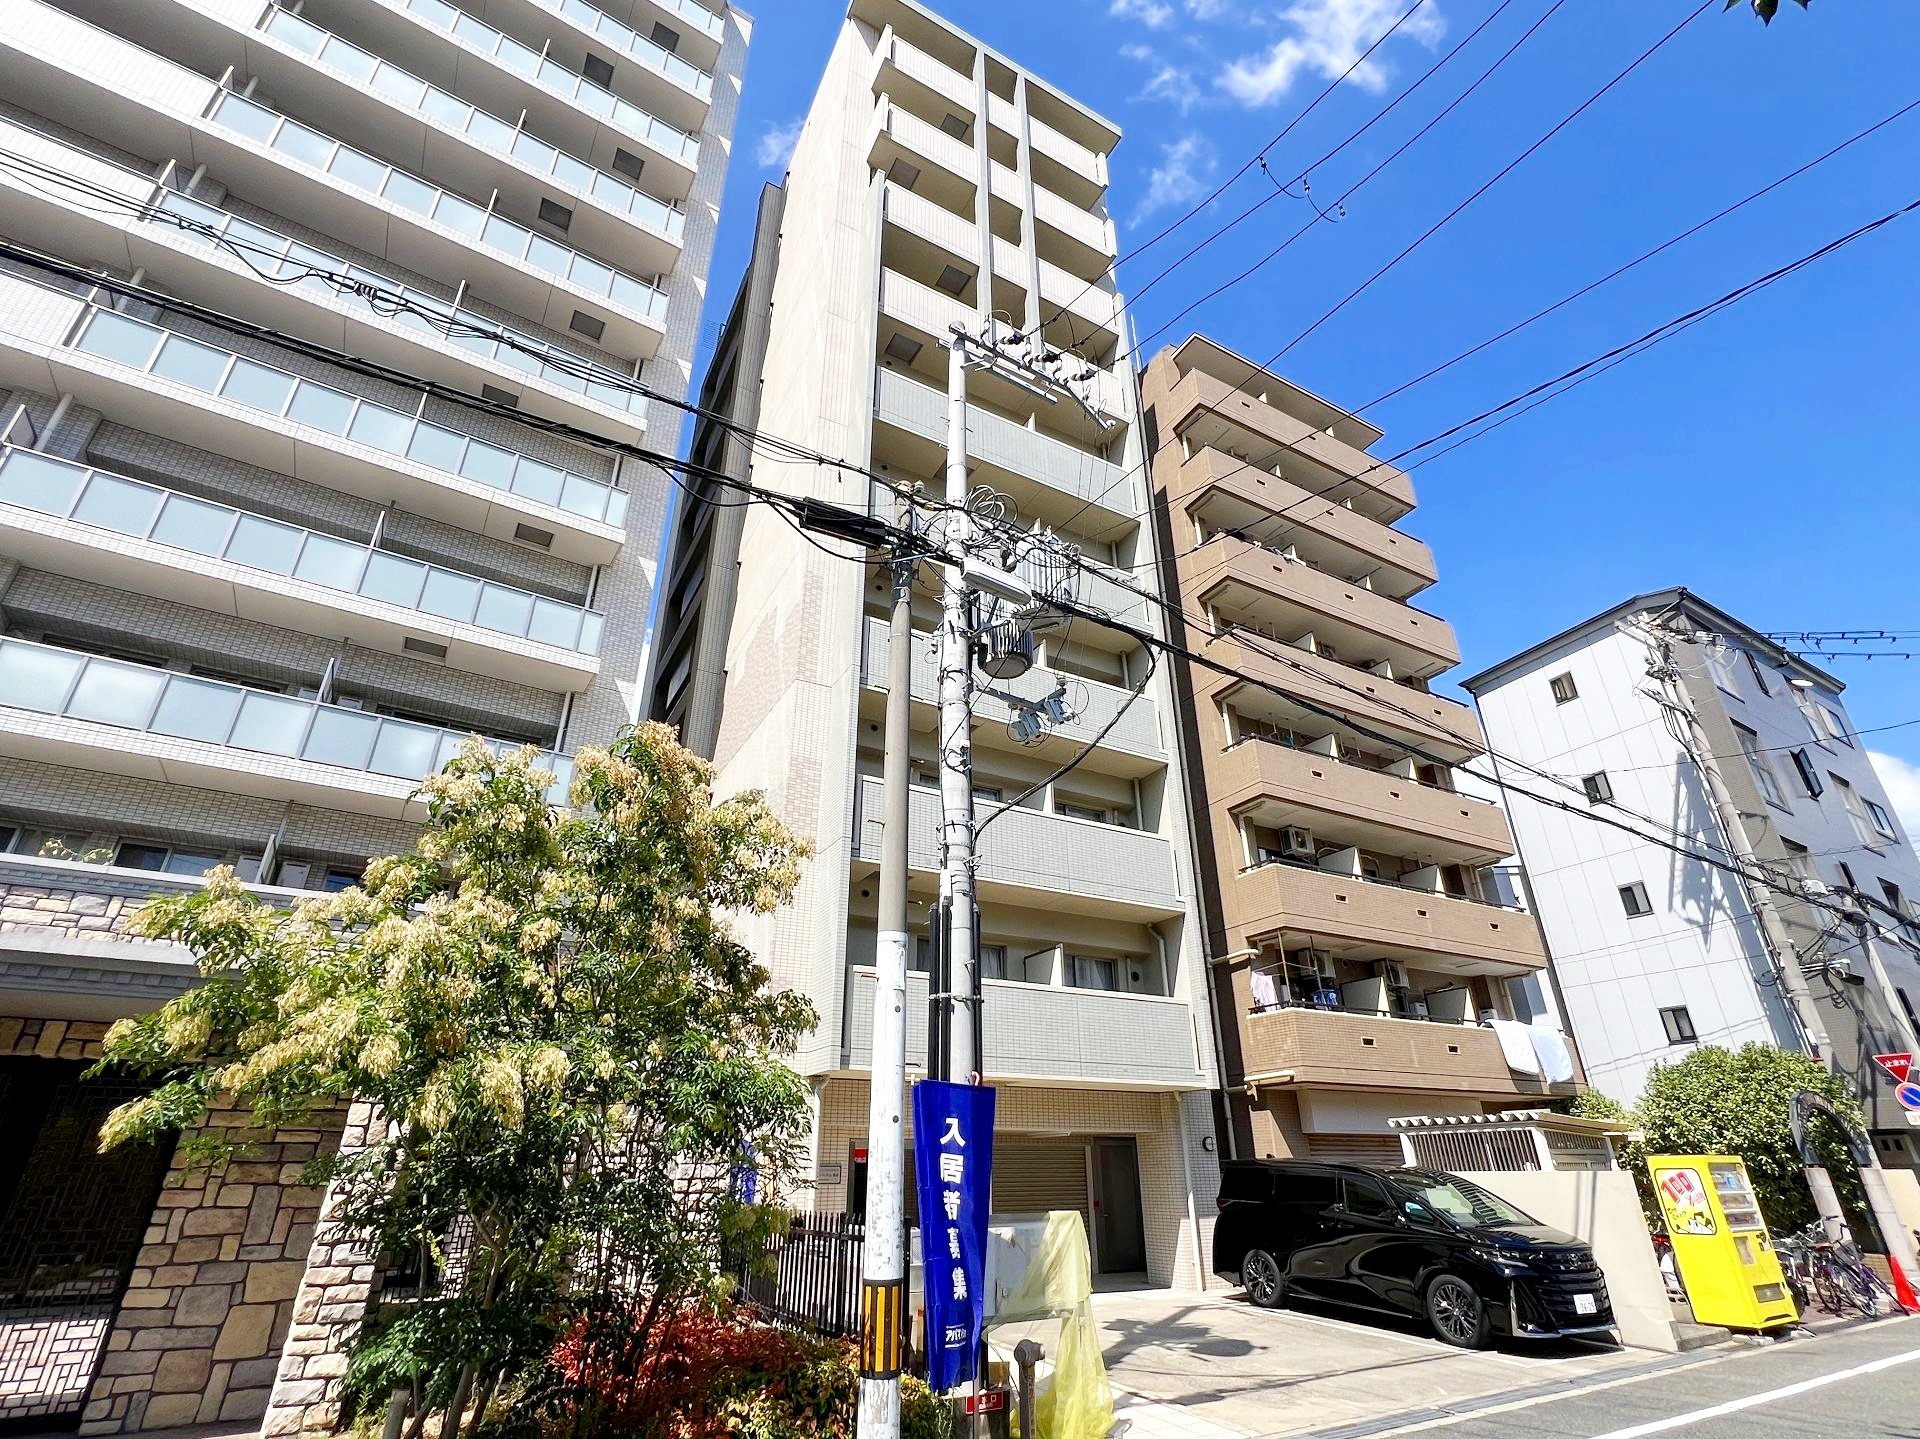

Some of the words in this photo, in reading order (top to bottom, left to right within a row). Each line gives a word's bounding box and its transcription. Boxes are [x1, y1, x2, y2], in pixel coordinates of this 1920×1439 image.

[1885, 1059, 1909, 1068] 止まれ
[1660, 1171, 1695, 1204] 100
